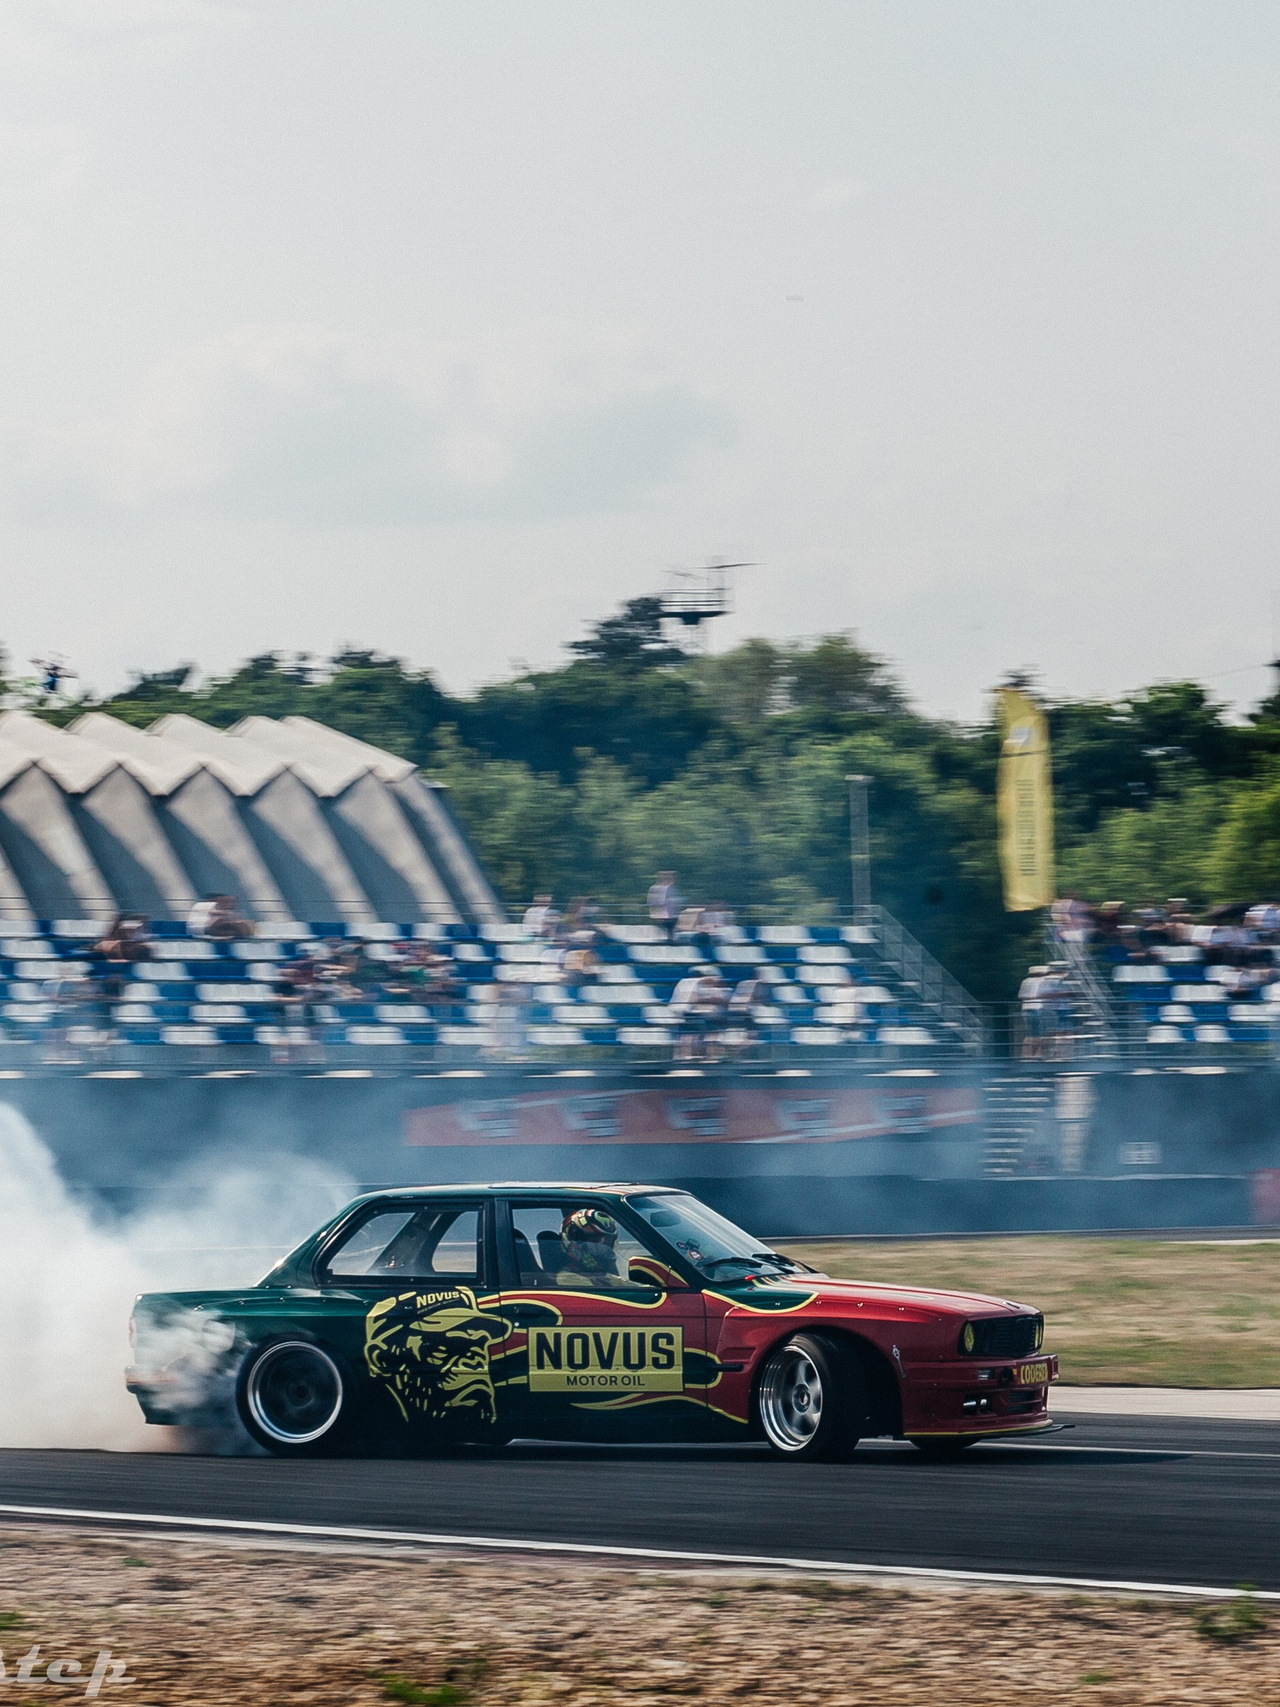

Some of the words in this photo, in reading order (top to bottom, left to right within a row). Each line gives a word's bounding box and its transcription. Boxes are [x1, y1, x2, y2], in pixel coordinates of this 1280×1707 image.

[416, 1291, 460, 1309] NOVUS
[536, 1332, 675, 1370] NOVUS
[566, 1375, 618, 1387] MOTOR
[621, 1375, 646, 1387] OIL
